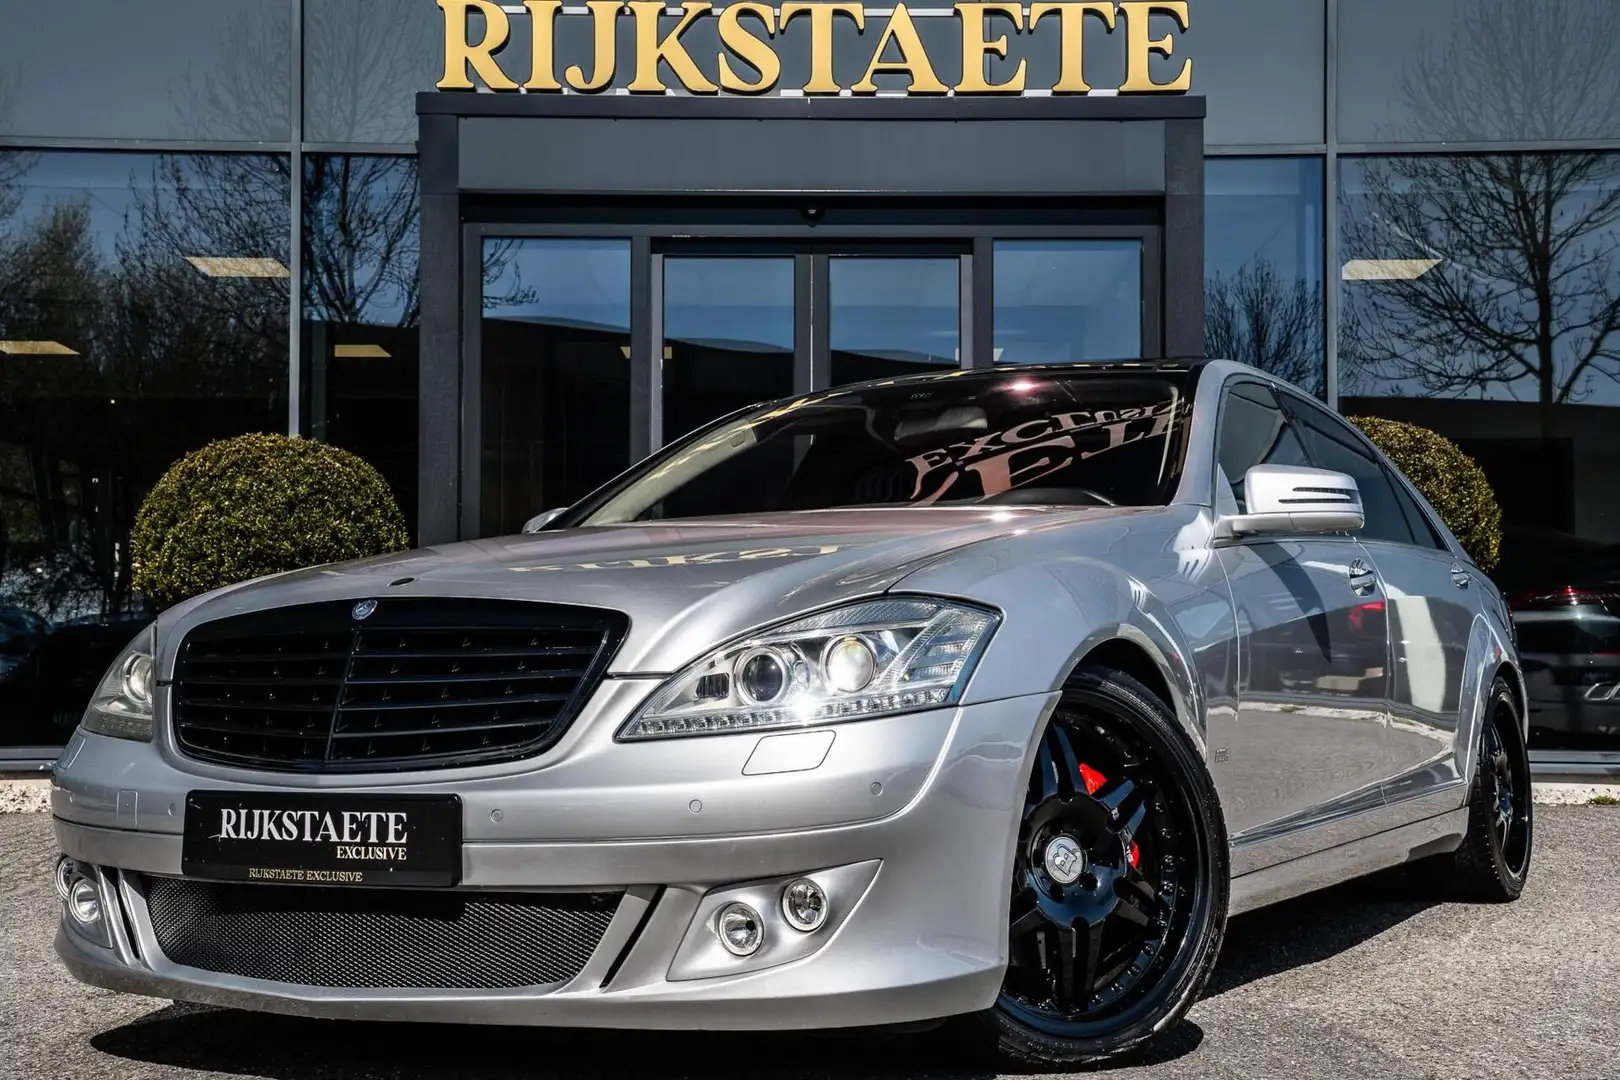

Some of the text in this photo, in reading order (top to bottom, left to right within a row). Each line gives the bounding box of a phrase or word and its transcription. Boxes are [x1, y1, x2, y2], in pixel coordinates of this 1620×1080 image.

[436, 0, 1192, 95] RIJKSTAETE
[219, 808, 408, 844] RIJKSTAETE
[336, 845, 407, 861] EXCLUSIVE
[249, 867, 364, 883] RIJKSTAETE EXCLUSIVE
